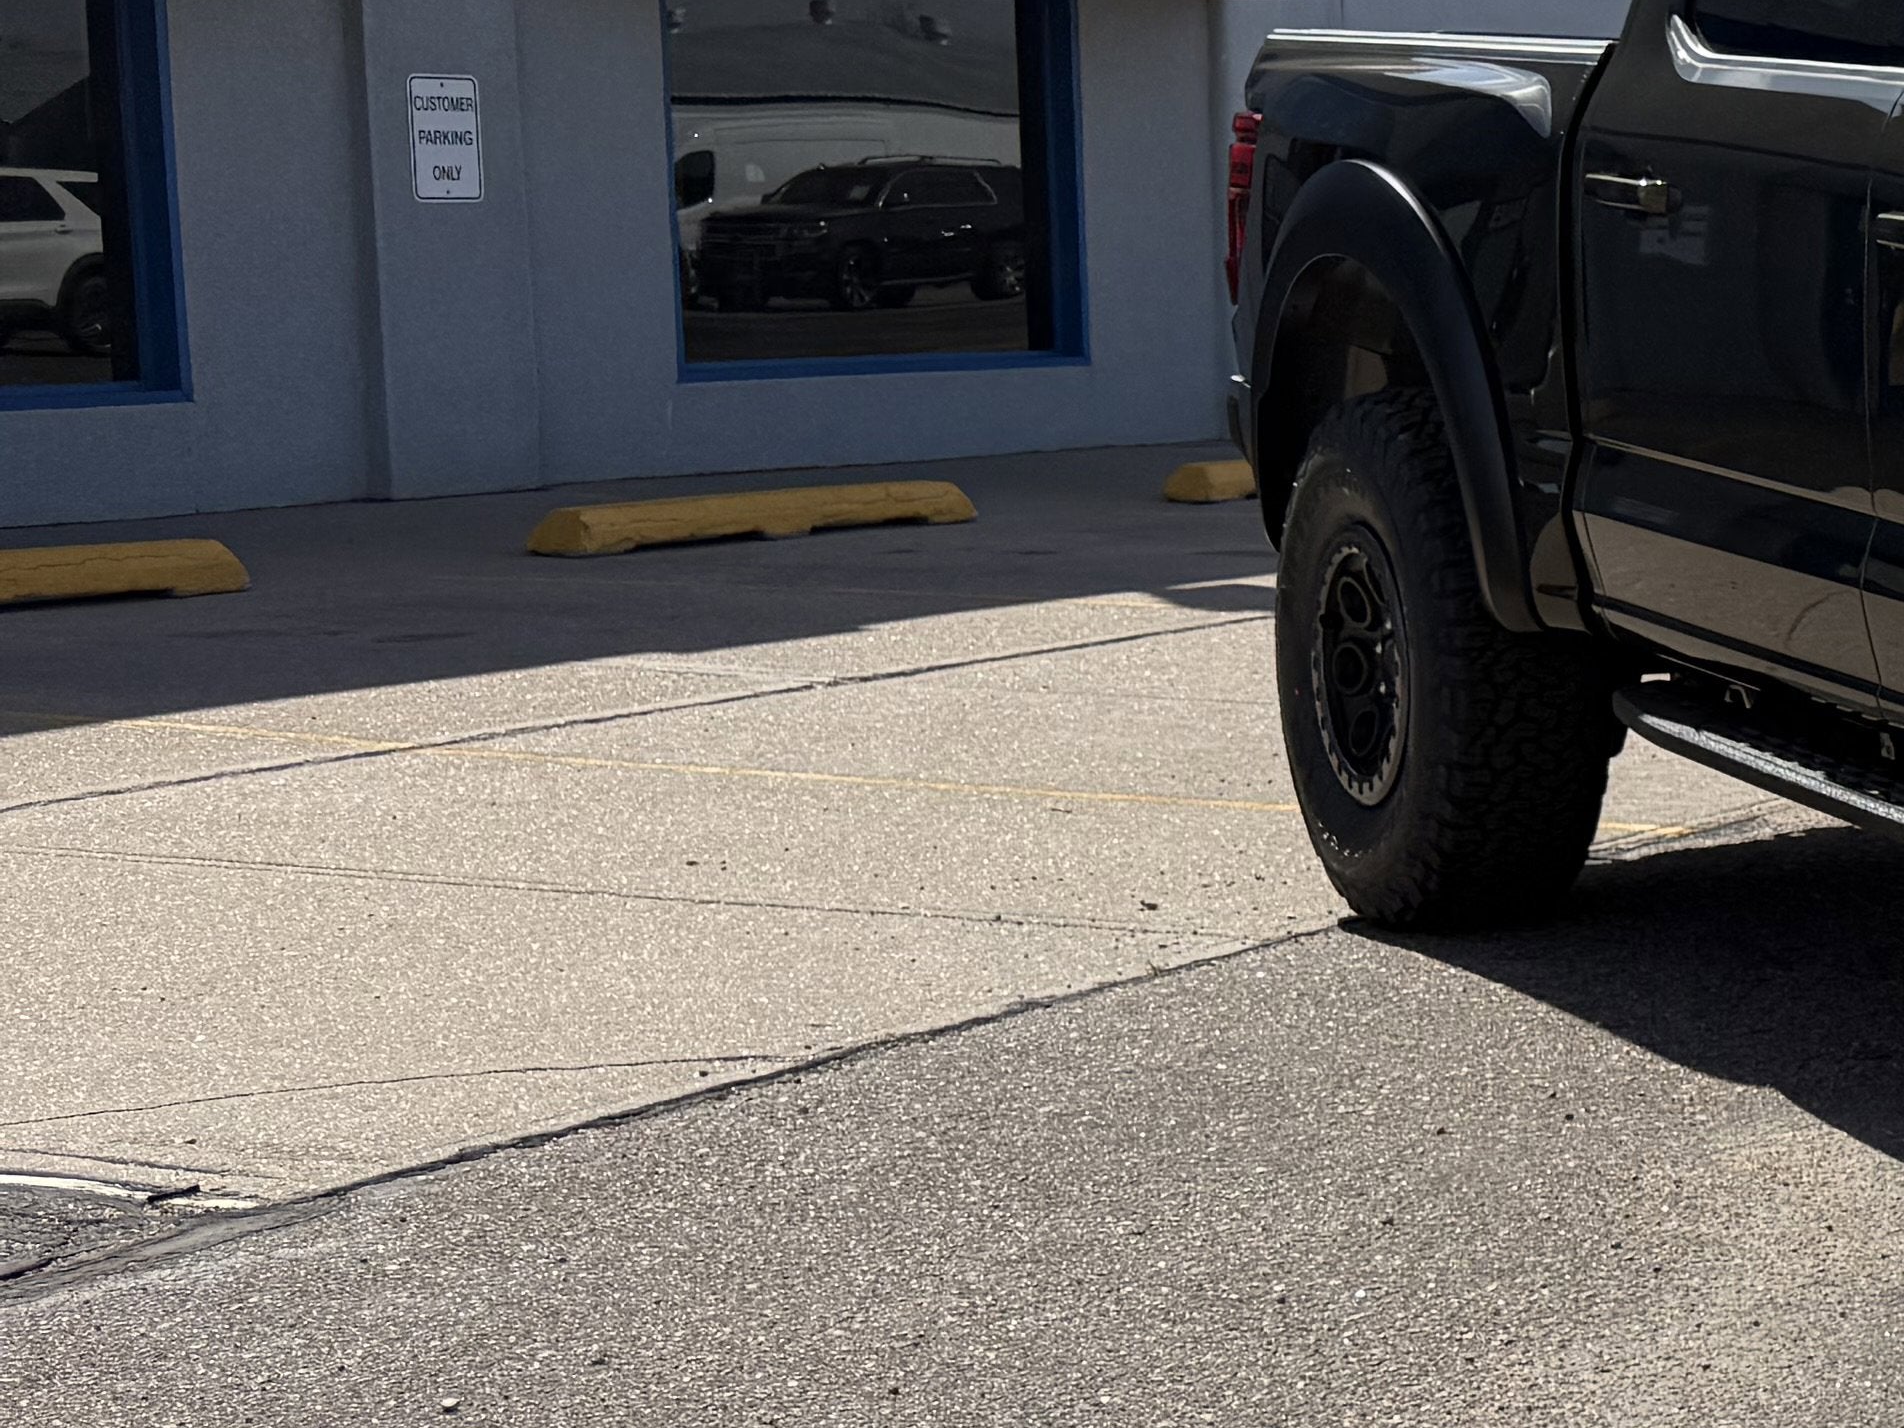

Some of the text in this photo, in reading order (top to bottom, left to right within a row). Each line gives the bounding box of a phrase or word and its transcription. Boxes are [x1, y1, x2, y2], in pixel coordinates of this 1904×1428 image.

[413, 95, 474, 113] CUSTOMER
[417, 129, 474, 146] PARKING
[432, 165, 462, 181] ONLY
